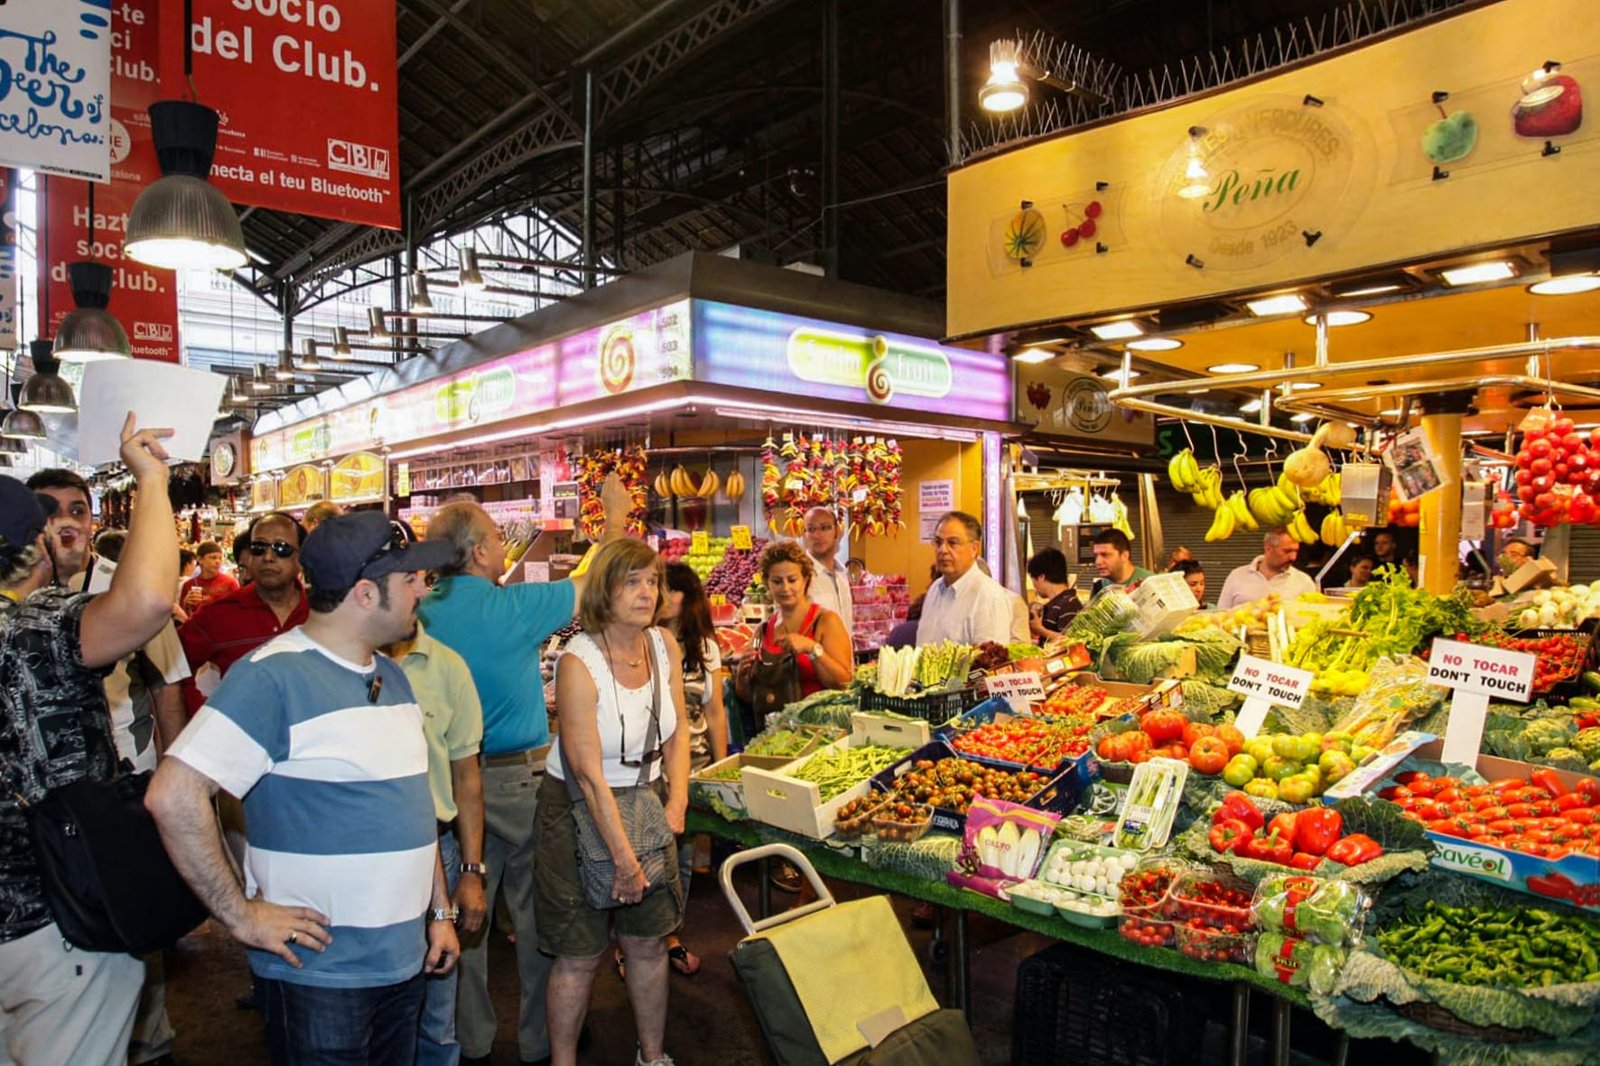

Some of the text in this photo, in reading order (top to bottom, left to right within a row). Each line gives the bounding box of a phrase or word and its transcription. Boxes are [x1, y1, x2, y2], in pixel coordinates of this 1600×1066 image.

[191, 16, 379, 92] del Club.
[110, 55, 161, 84] lub.
[260, 170, 274, 185] el
[280, 172, 305, 190] teu
[1202, 167, 1300, 213] Peña
[1260, 219, 1298, 248] 1923
[111, 268, 165, 293] lub.
[1443, 653, 1519, 676] NO TOCAR
[993, 680, 1004, 688] NO
[1232, 676, 1302, 703] DON'T TOUCH
[1244, 667, 1300, 689] NO TOCAR
[1430, 667, 1526, 694] DON'T TOUCH
[1017, 687, 1042, 697] TOUCH
